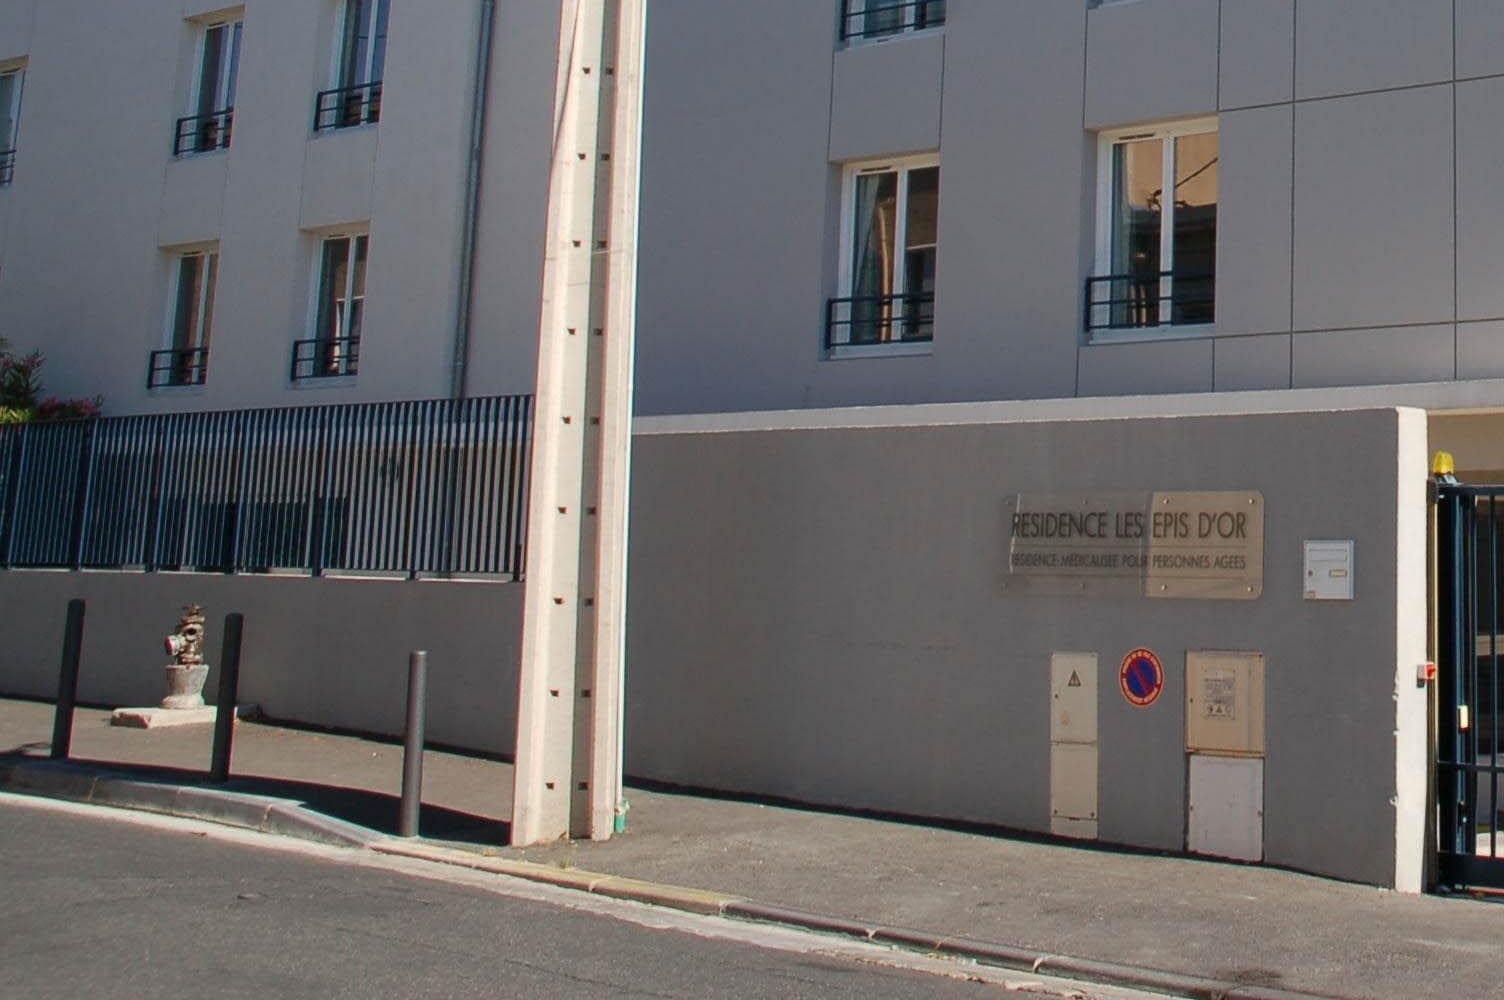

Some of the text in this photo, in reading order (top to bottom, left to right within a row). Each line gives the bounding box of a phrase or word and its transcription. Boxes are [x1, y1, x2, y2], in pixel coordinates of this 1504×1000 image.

[1011, 511, 1247, 538] RESIDENCE LES EPIS D'OR
[1152, 554, 1210, 569] PERSONNES
[1213, 554, 1246, 569] AGEES
